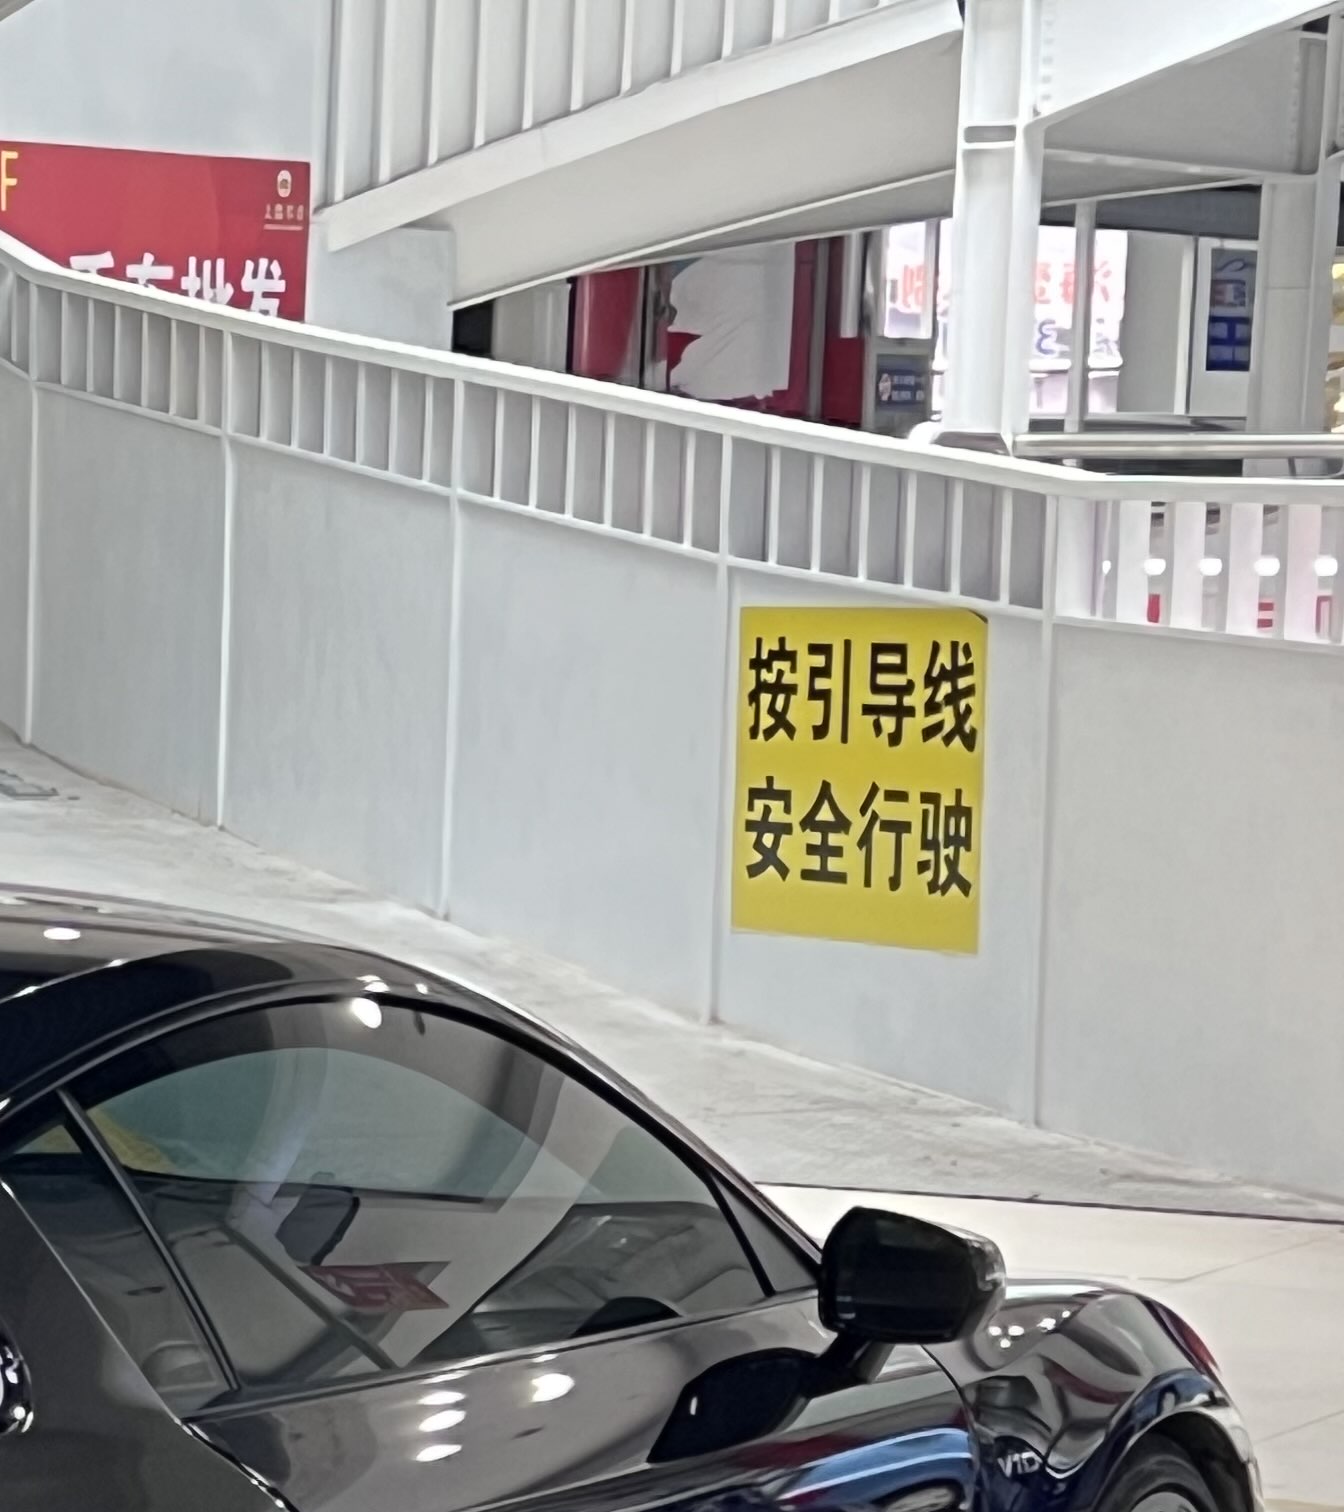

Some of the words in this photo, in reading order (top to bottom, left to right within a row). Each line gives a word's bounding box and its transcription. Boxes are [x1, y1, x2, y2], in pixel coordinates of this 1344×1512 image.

[748, 635, 977, 752] 按引导线
[745, 774, 973, 897] 安全行驶
